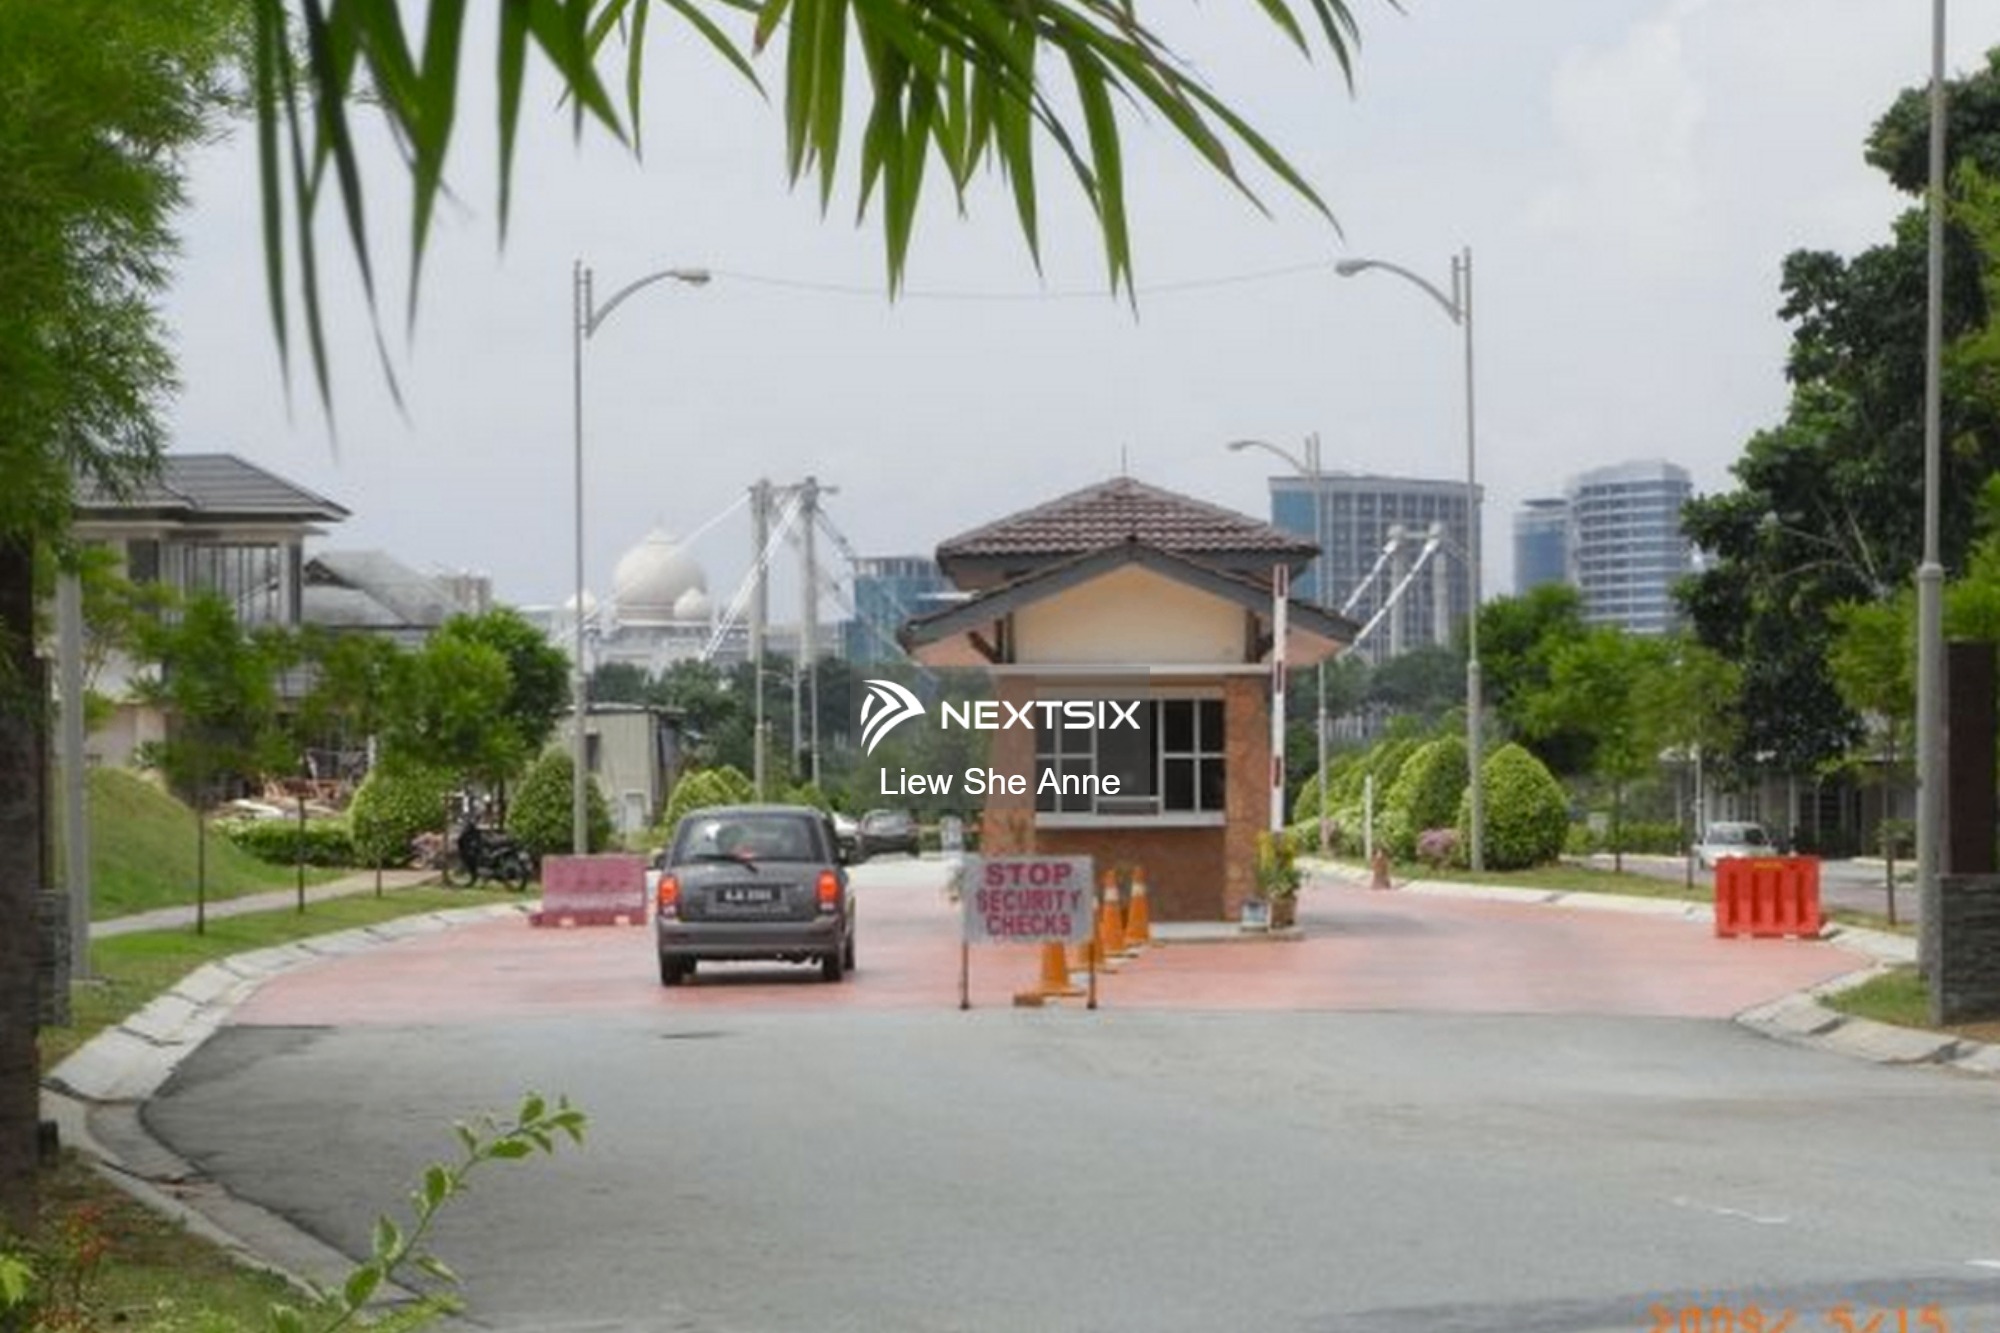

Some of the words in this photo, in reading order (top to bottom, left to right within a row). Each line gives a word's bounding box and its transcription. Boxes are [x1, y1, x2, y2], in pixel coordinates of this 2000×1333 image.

[986, 863, 1073, 886] STOP
[976, 889, 1082, 913] SECURITY
[986, 914, 1073, 937] CHECKS
